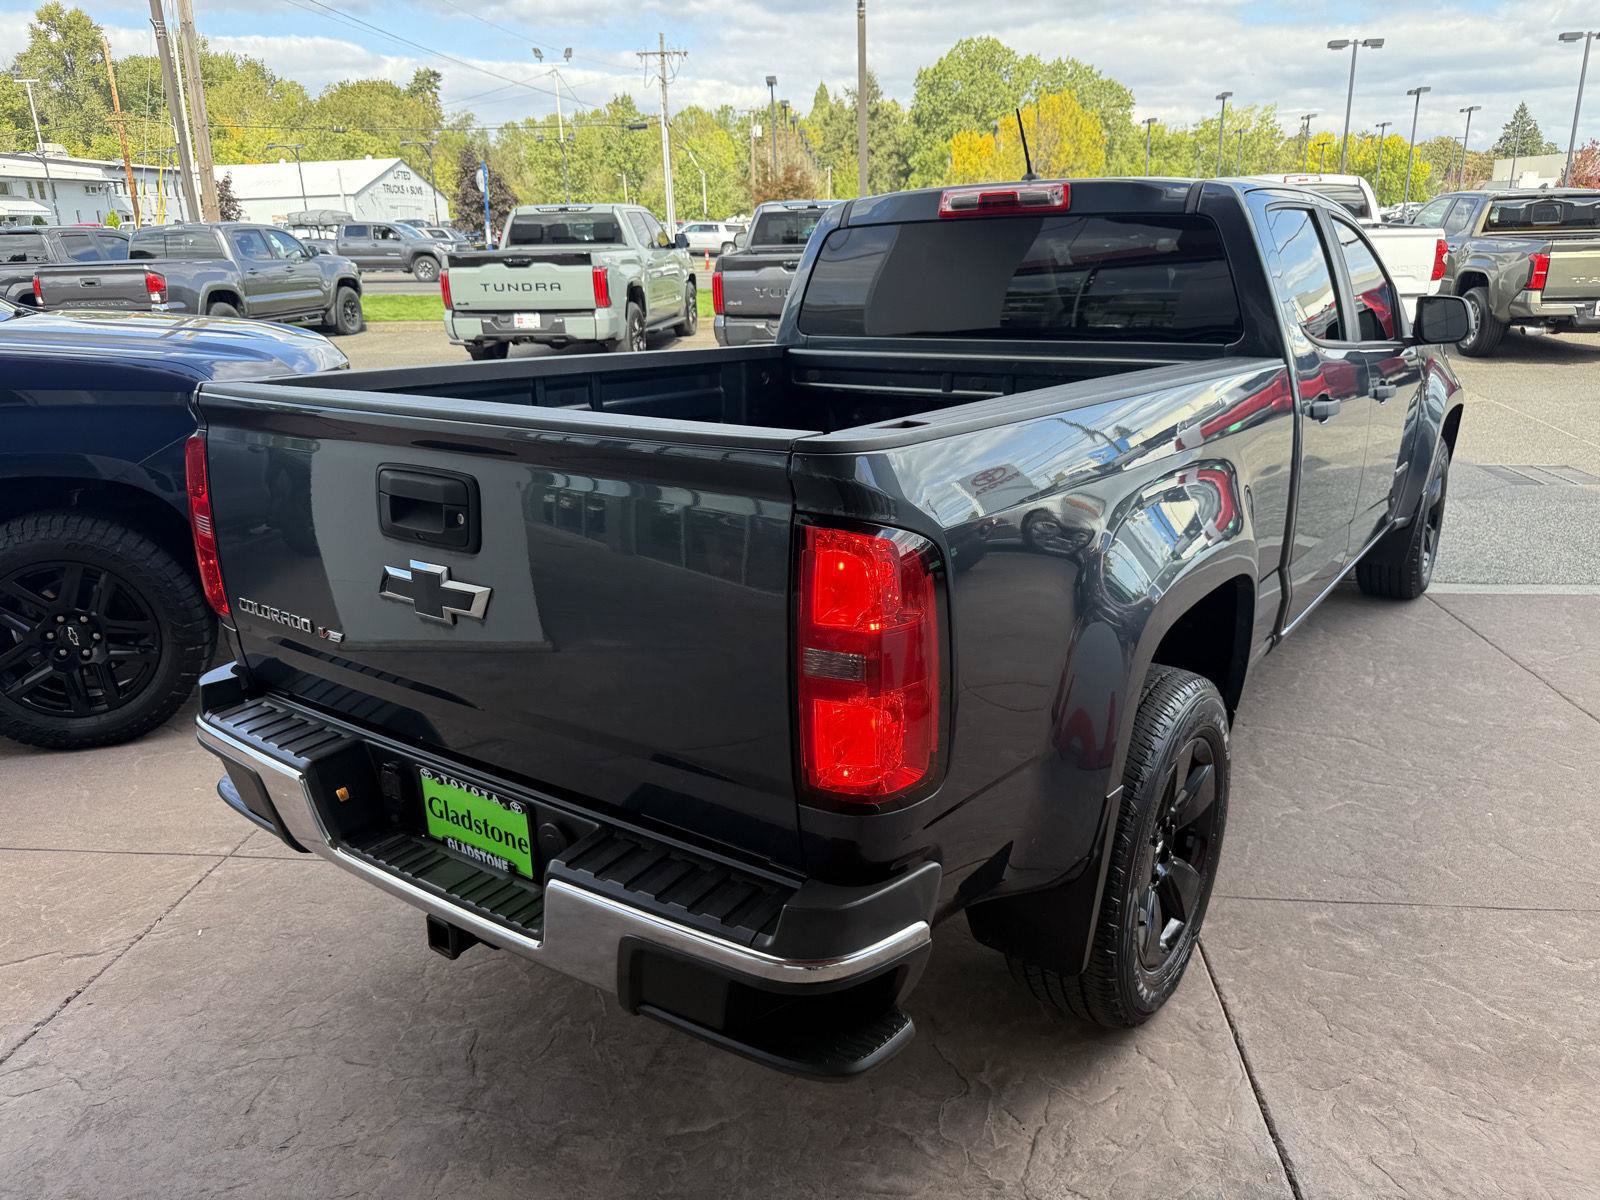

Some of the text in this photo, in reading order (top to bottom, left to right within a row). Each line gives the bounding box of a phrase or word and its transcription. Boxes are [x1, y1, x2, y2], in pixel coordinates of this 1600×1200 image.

[382, 183, 405, 194] TRUCKS
[480, 282, 562, 292] TUNDRA
[238, 597, 313, 634] COLORADO
[440, 774, 501, 807] TOYOTA
[427, 796, 529, 855] Gladstone
[447, 838, 510, 873] GLADSTONE
